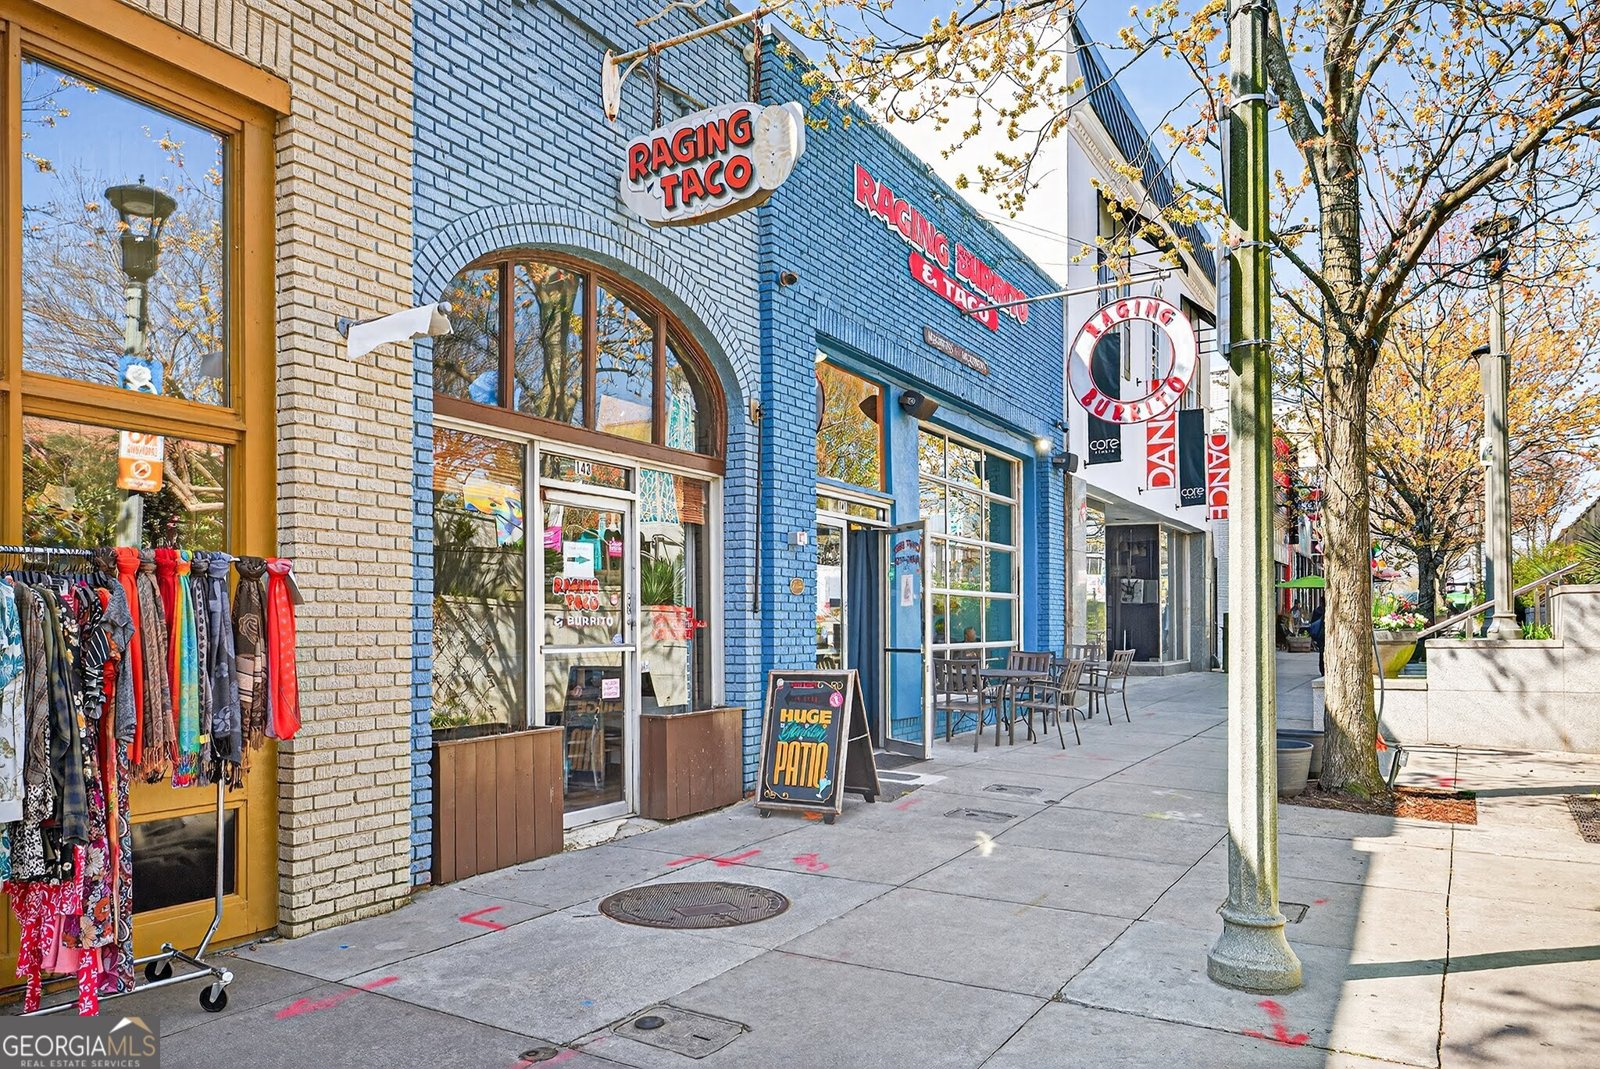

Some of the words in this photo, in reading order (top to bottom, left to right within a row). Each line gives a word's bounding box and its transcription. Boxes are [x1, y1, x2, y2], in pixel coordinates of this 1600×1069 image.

[628, 108, 754, 184] RAGING
[659, 154, 754, 210] TACO
[855, 162, 949, 270] RAGING
[955, 243, 1029, 324] BURRITO
[922, 265, 938, 288] &
[943, 279, 990, 323] TACO
[1083, 299, 1176, 339] RAGING
[1081, 376, 1185, 421] BURRITO
[1089, 438, 1120, 451] core
[576, 461, 592, 476] 143
[1208, 434, 1229, 520] DANCE
[1181, 487, 1205, 497] core
[553, 616, 564, 628] &
[567, 616, 613, 627] BURRITO
[780, 708, 833, 725] HUGE
[773, 741, 829, 788] PATIO
